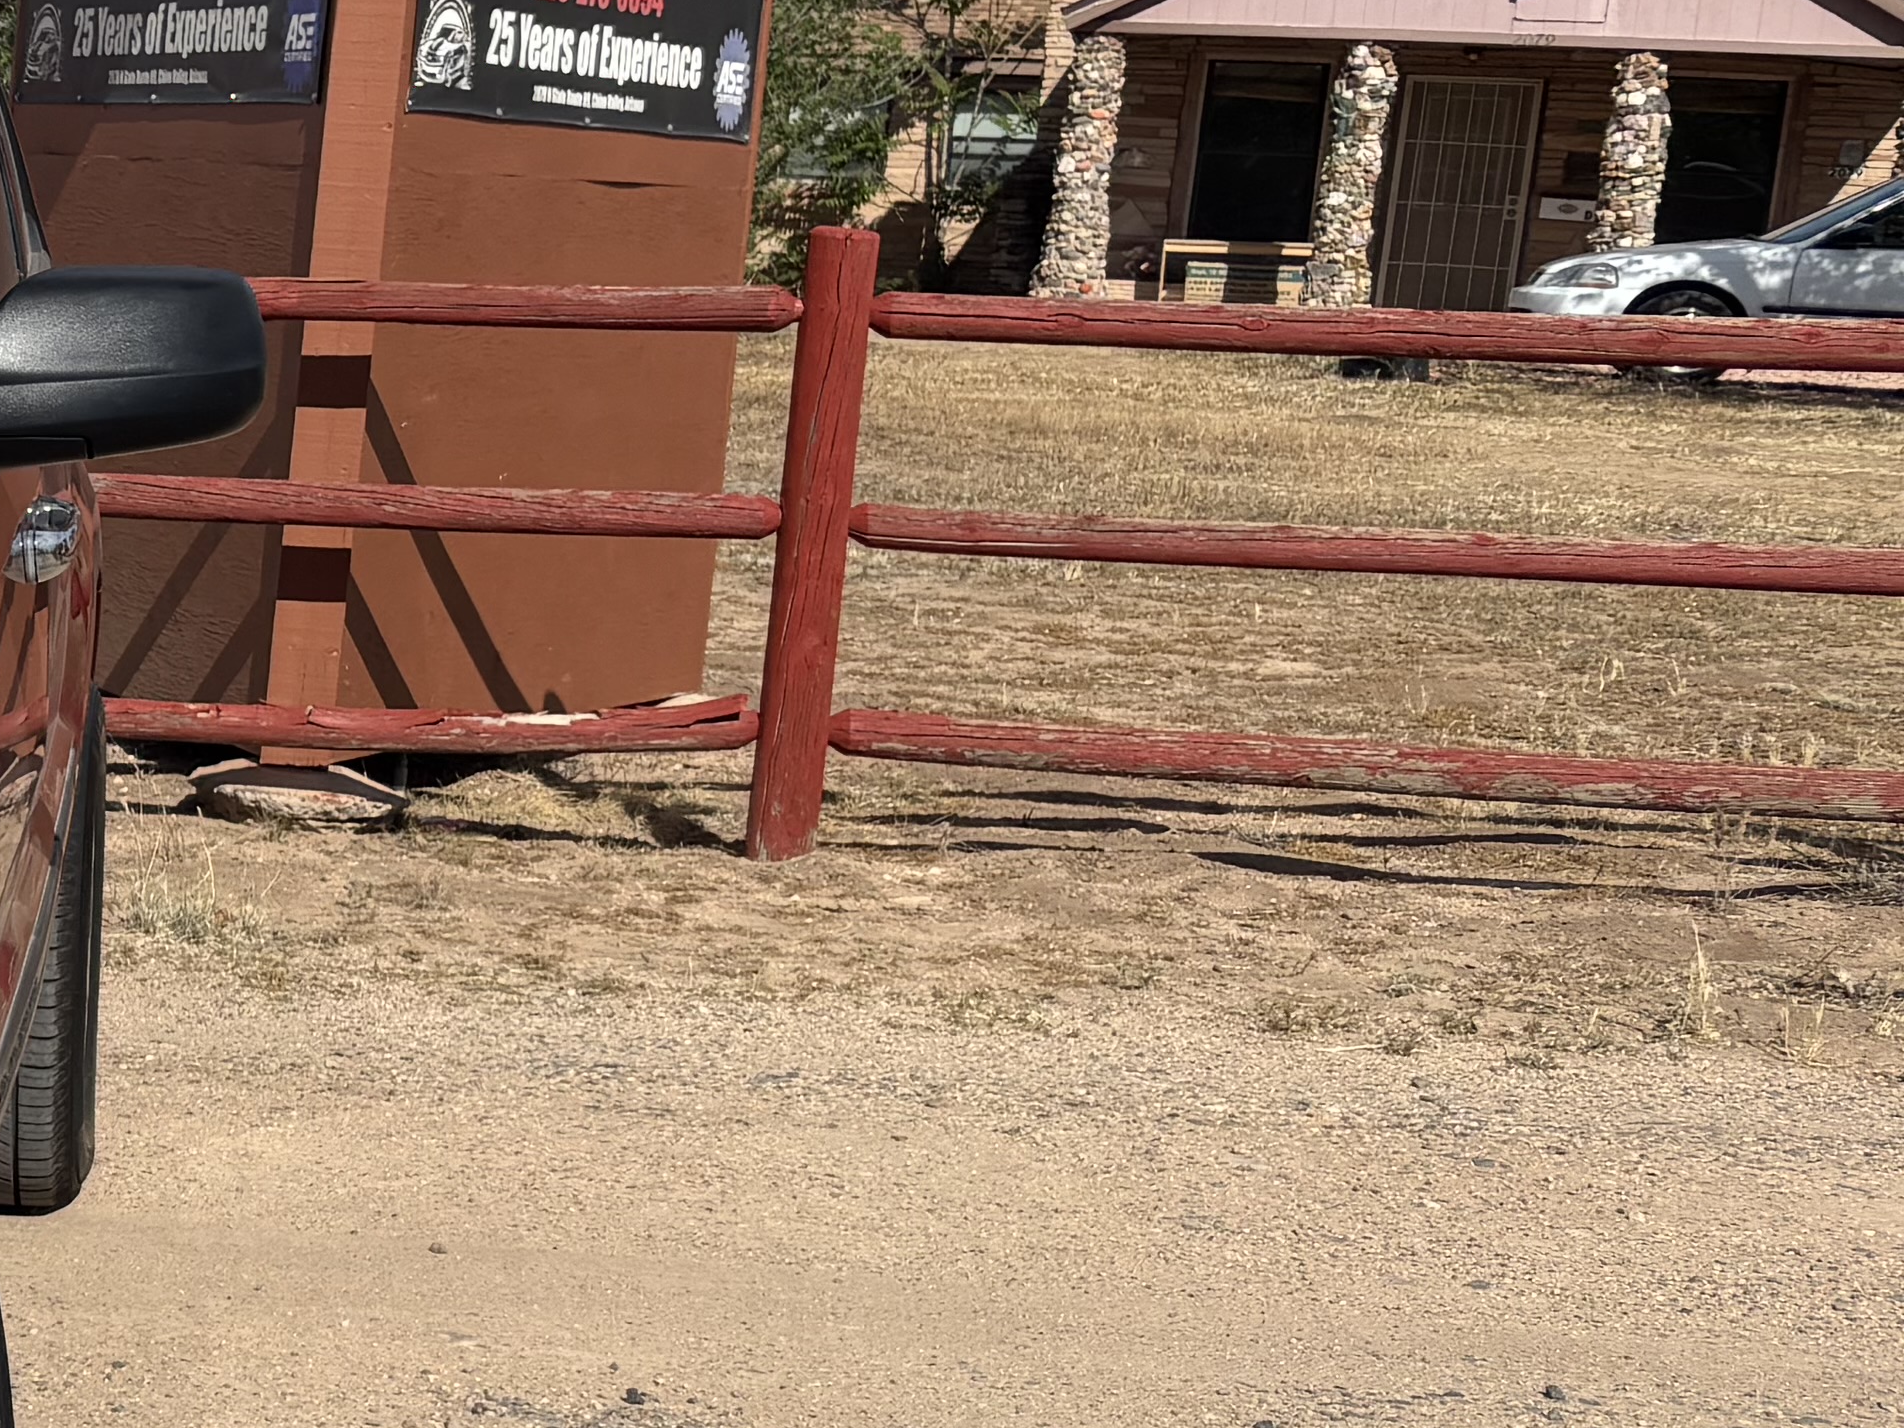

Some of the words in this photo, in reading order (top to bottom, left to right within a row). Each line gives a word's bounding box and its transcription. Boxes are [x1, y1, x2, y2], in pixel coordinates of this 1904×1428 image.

[72, 8, 95, 57] 25
[97, 6, 143, 56] Years
[145, 2, 166, 55] of
[165, 0, 268, 59] Experience
[284, 13, 317, 50] ASE
[486, 8, 517, 66] 25
[519, 13, 574, 75] Years
[576, 24, 600, 77] of
[599, 26, 702, 90] Experience
[716, 60, 745, 95] ASE
